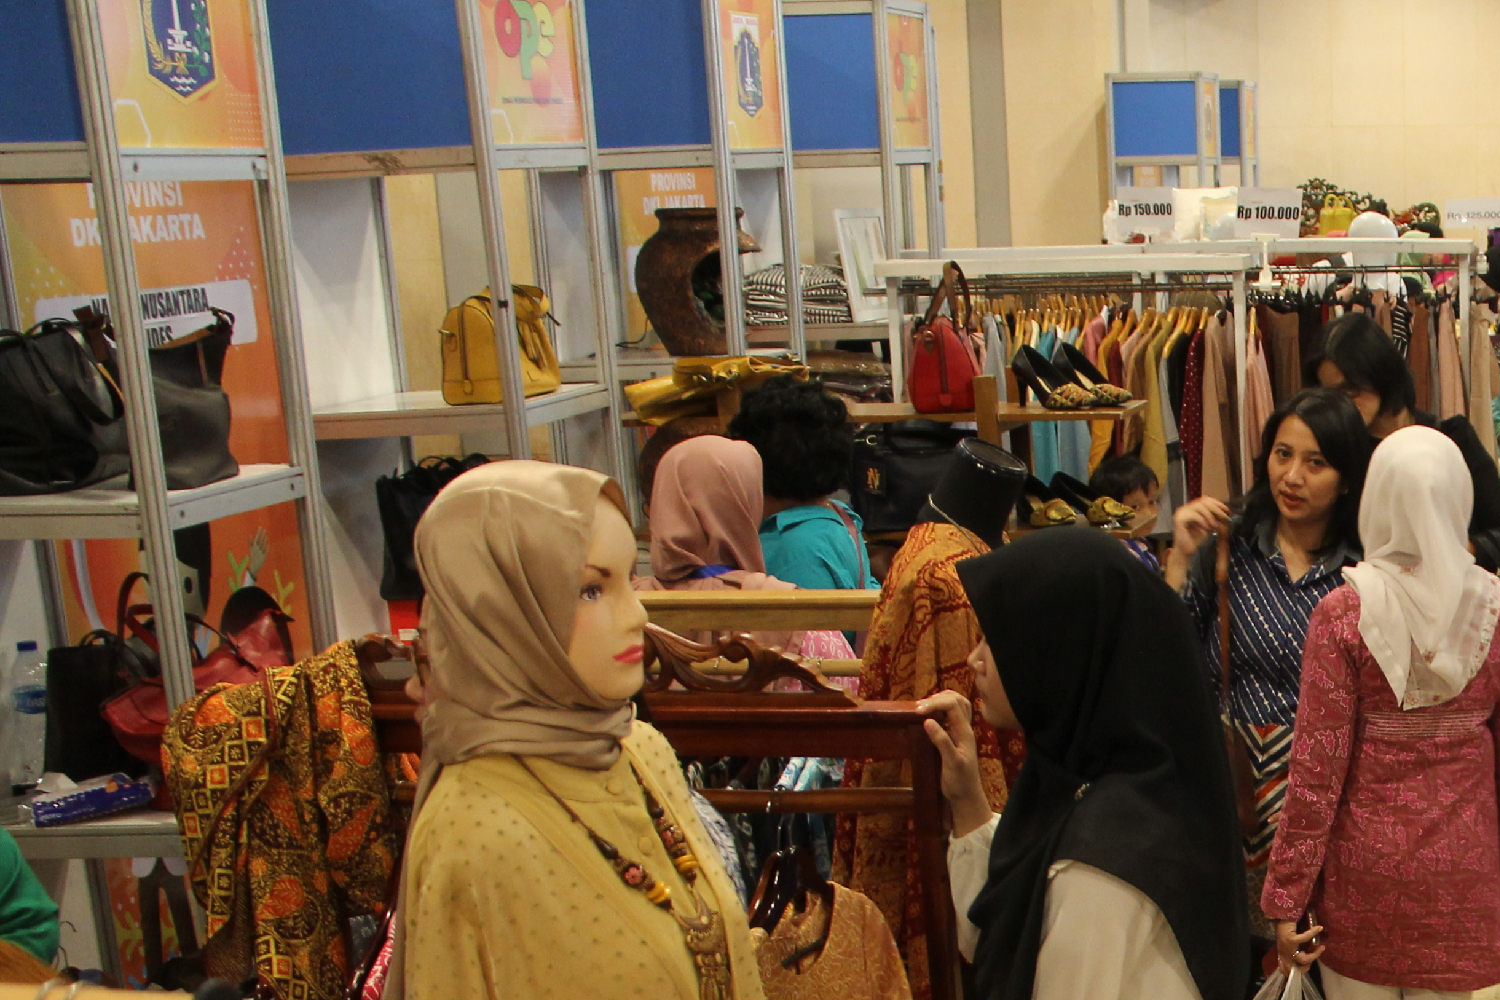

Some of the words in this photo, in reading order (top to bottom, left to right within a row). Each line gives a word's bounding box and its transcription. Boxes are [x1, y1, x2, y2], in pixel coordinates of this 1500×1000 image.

[650, 172, 696, 192] PROVINSI
[1118, 204, 1131, 216] Rp
[1134, 203, 1172, 216] 150.000
[1237, 206, 1251, 220] Rp
[1255, 206, 1300, 220] 100.000
[127, 213, 206, 243] AKARTA
[141, 288, 209, 319] NUSANTARA
